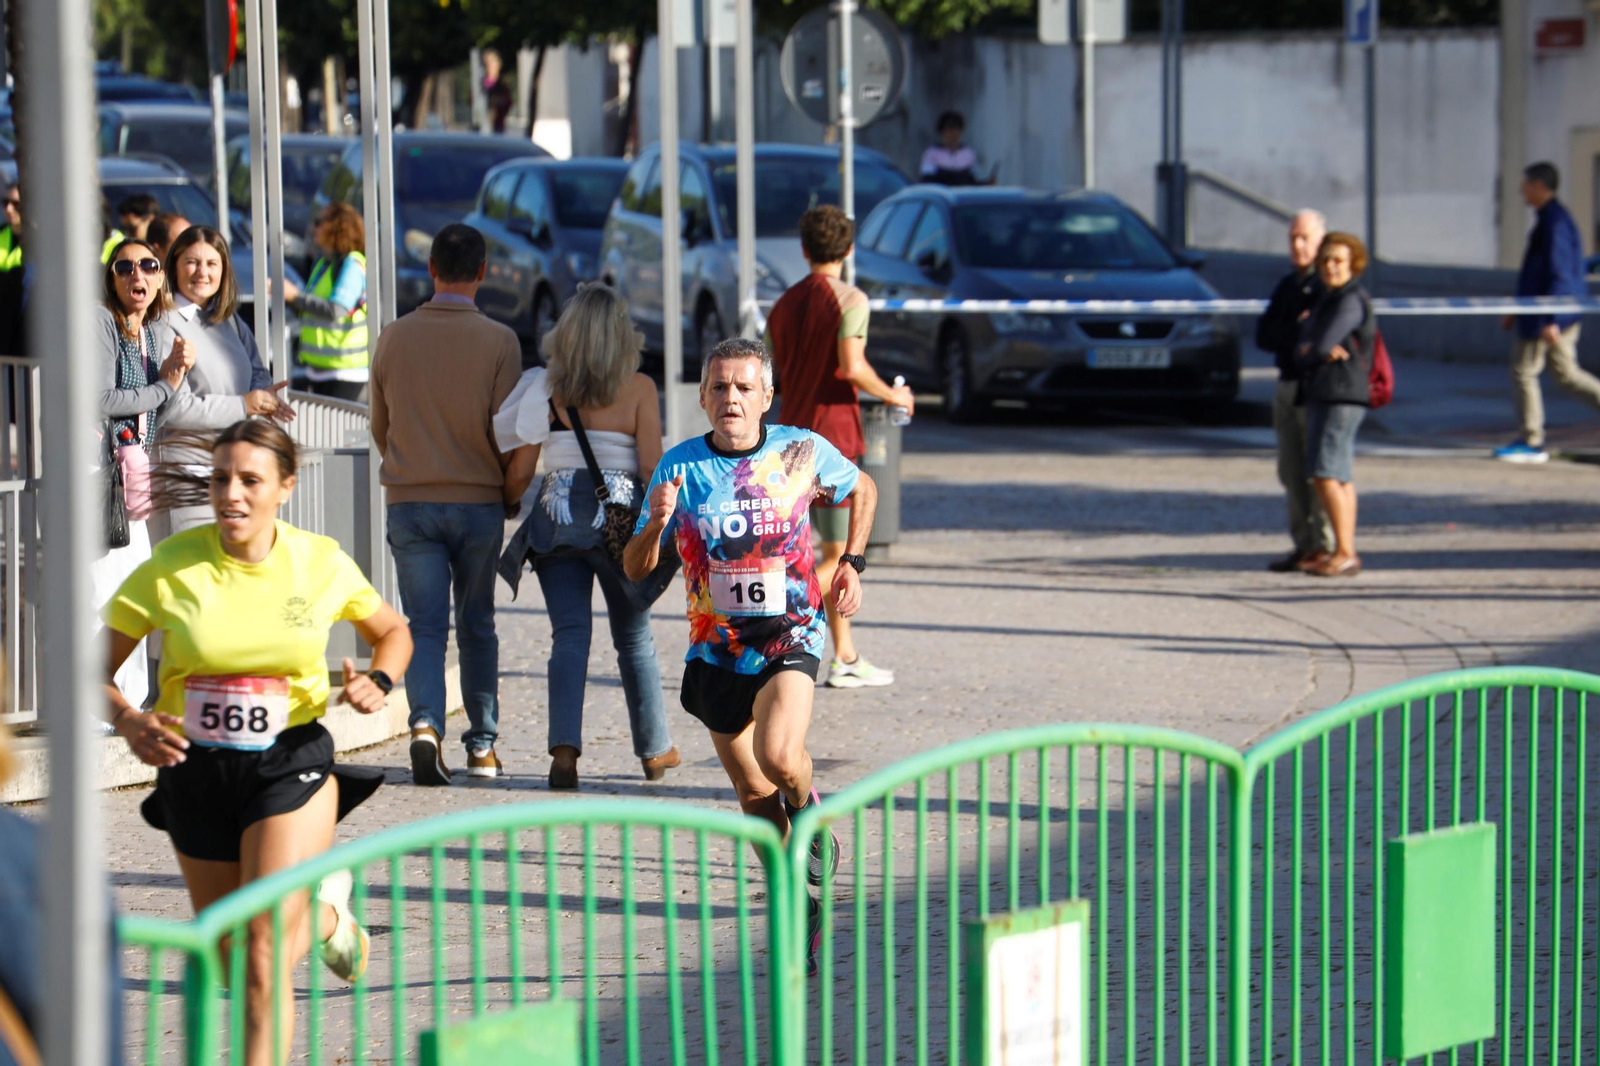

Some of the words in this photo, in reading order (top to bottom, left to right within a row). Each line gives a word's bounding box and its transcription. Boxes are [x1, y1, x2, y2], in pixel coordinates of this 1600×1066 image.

[697, 503, 715, 514] EL
[719, 497, 792, 513] CEREBRO
[698, 513, 748, 540] NO
[752, 510, 775, 524] ES
[752, 521, 791, 536] GRIS
[729, 581, 766, 604] 16
[200, 702, 268, 733] 568
